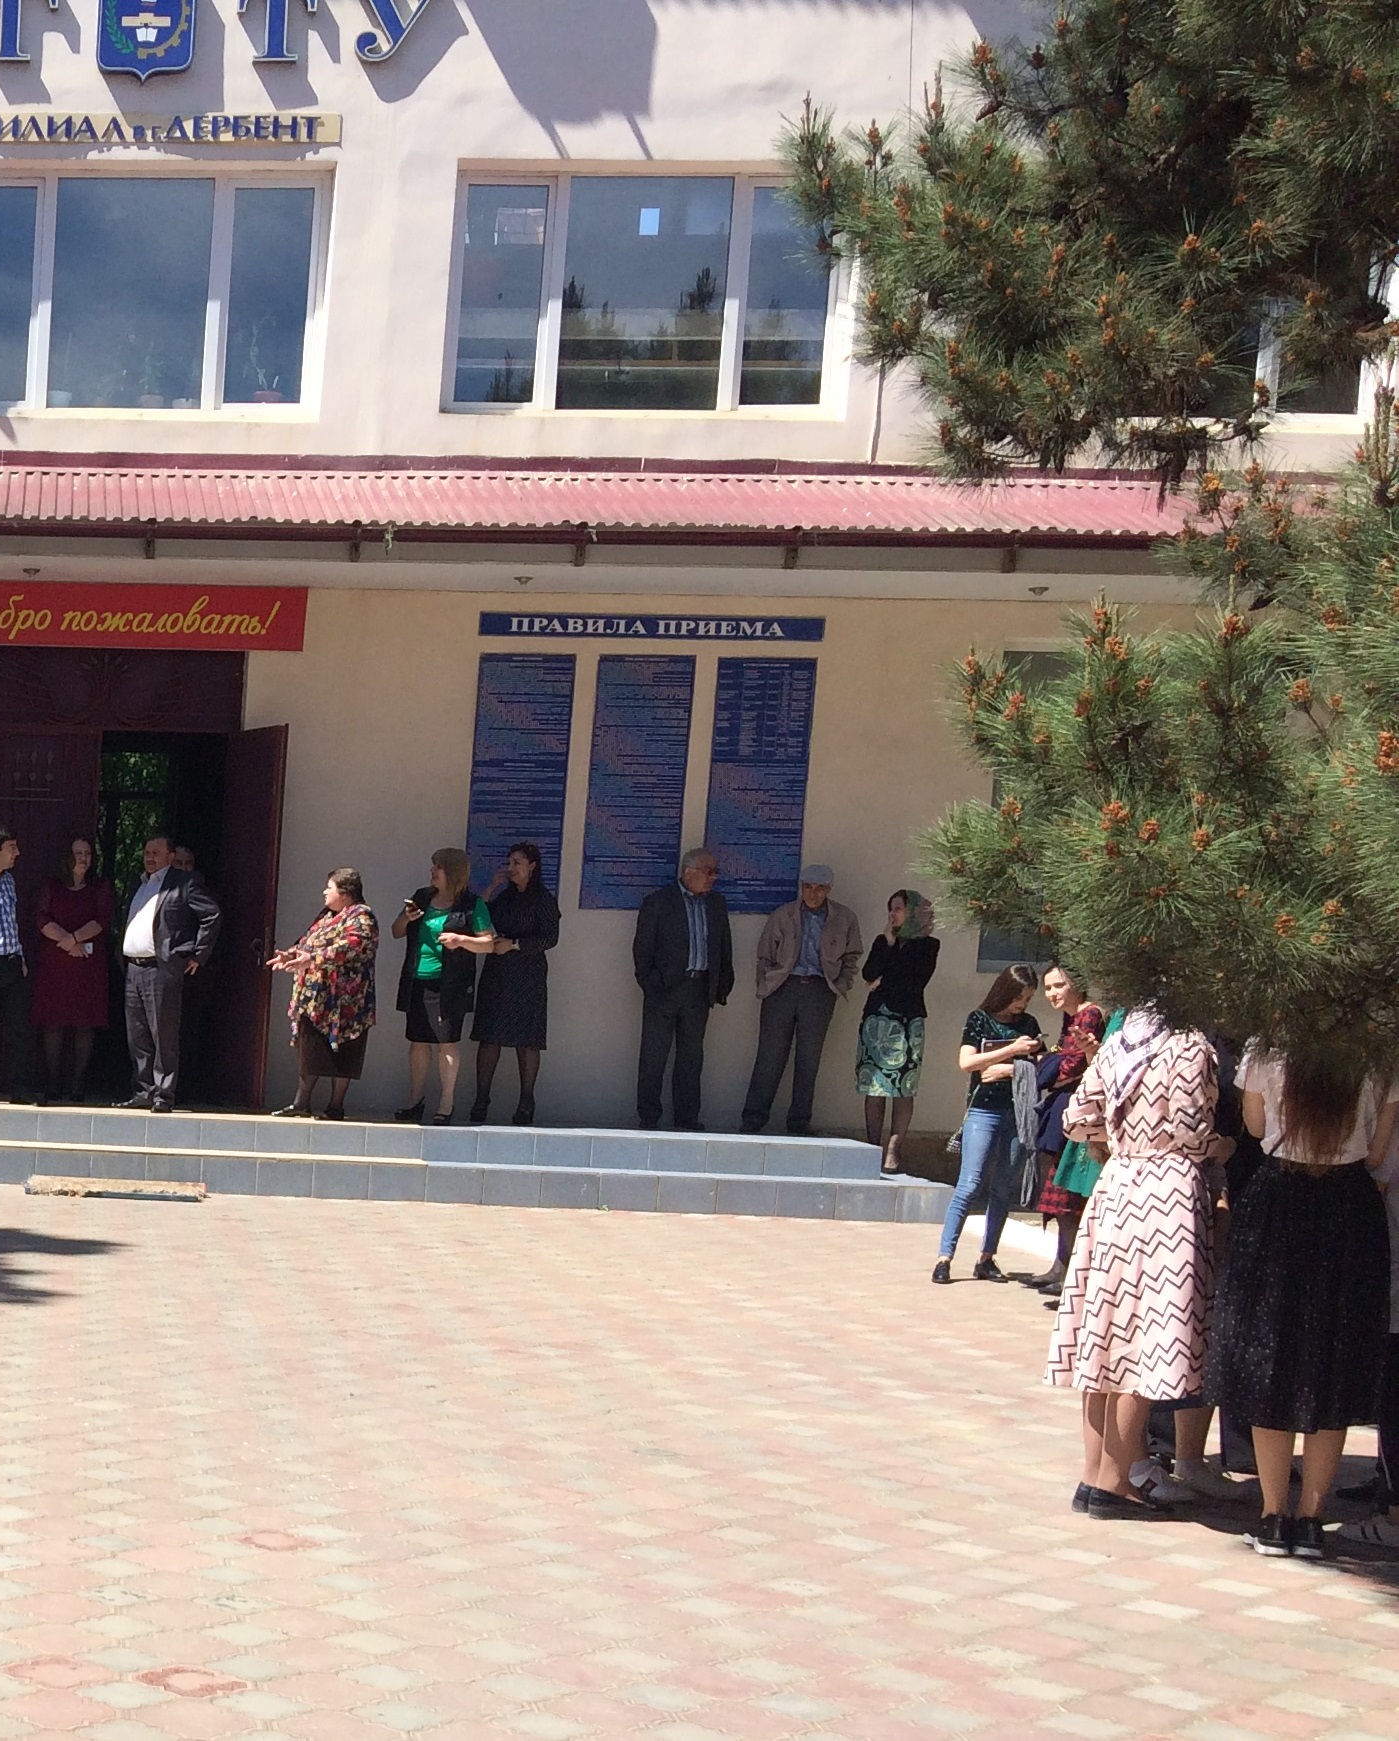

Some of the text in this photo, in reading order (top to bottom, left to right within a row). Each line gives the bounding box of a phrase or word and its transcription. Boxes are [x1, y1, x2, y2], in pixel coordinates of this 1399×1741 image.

[164, 115, 321, 140] ДЕРБЕНТ
[59, 595, 282, 636] пожаловать!
[509, 616, 785, 637] ПРАВИЛА ПРИЕМА
